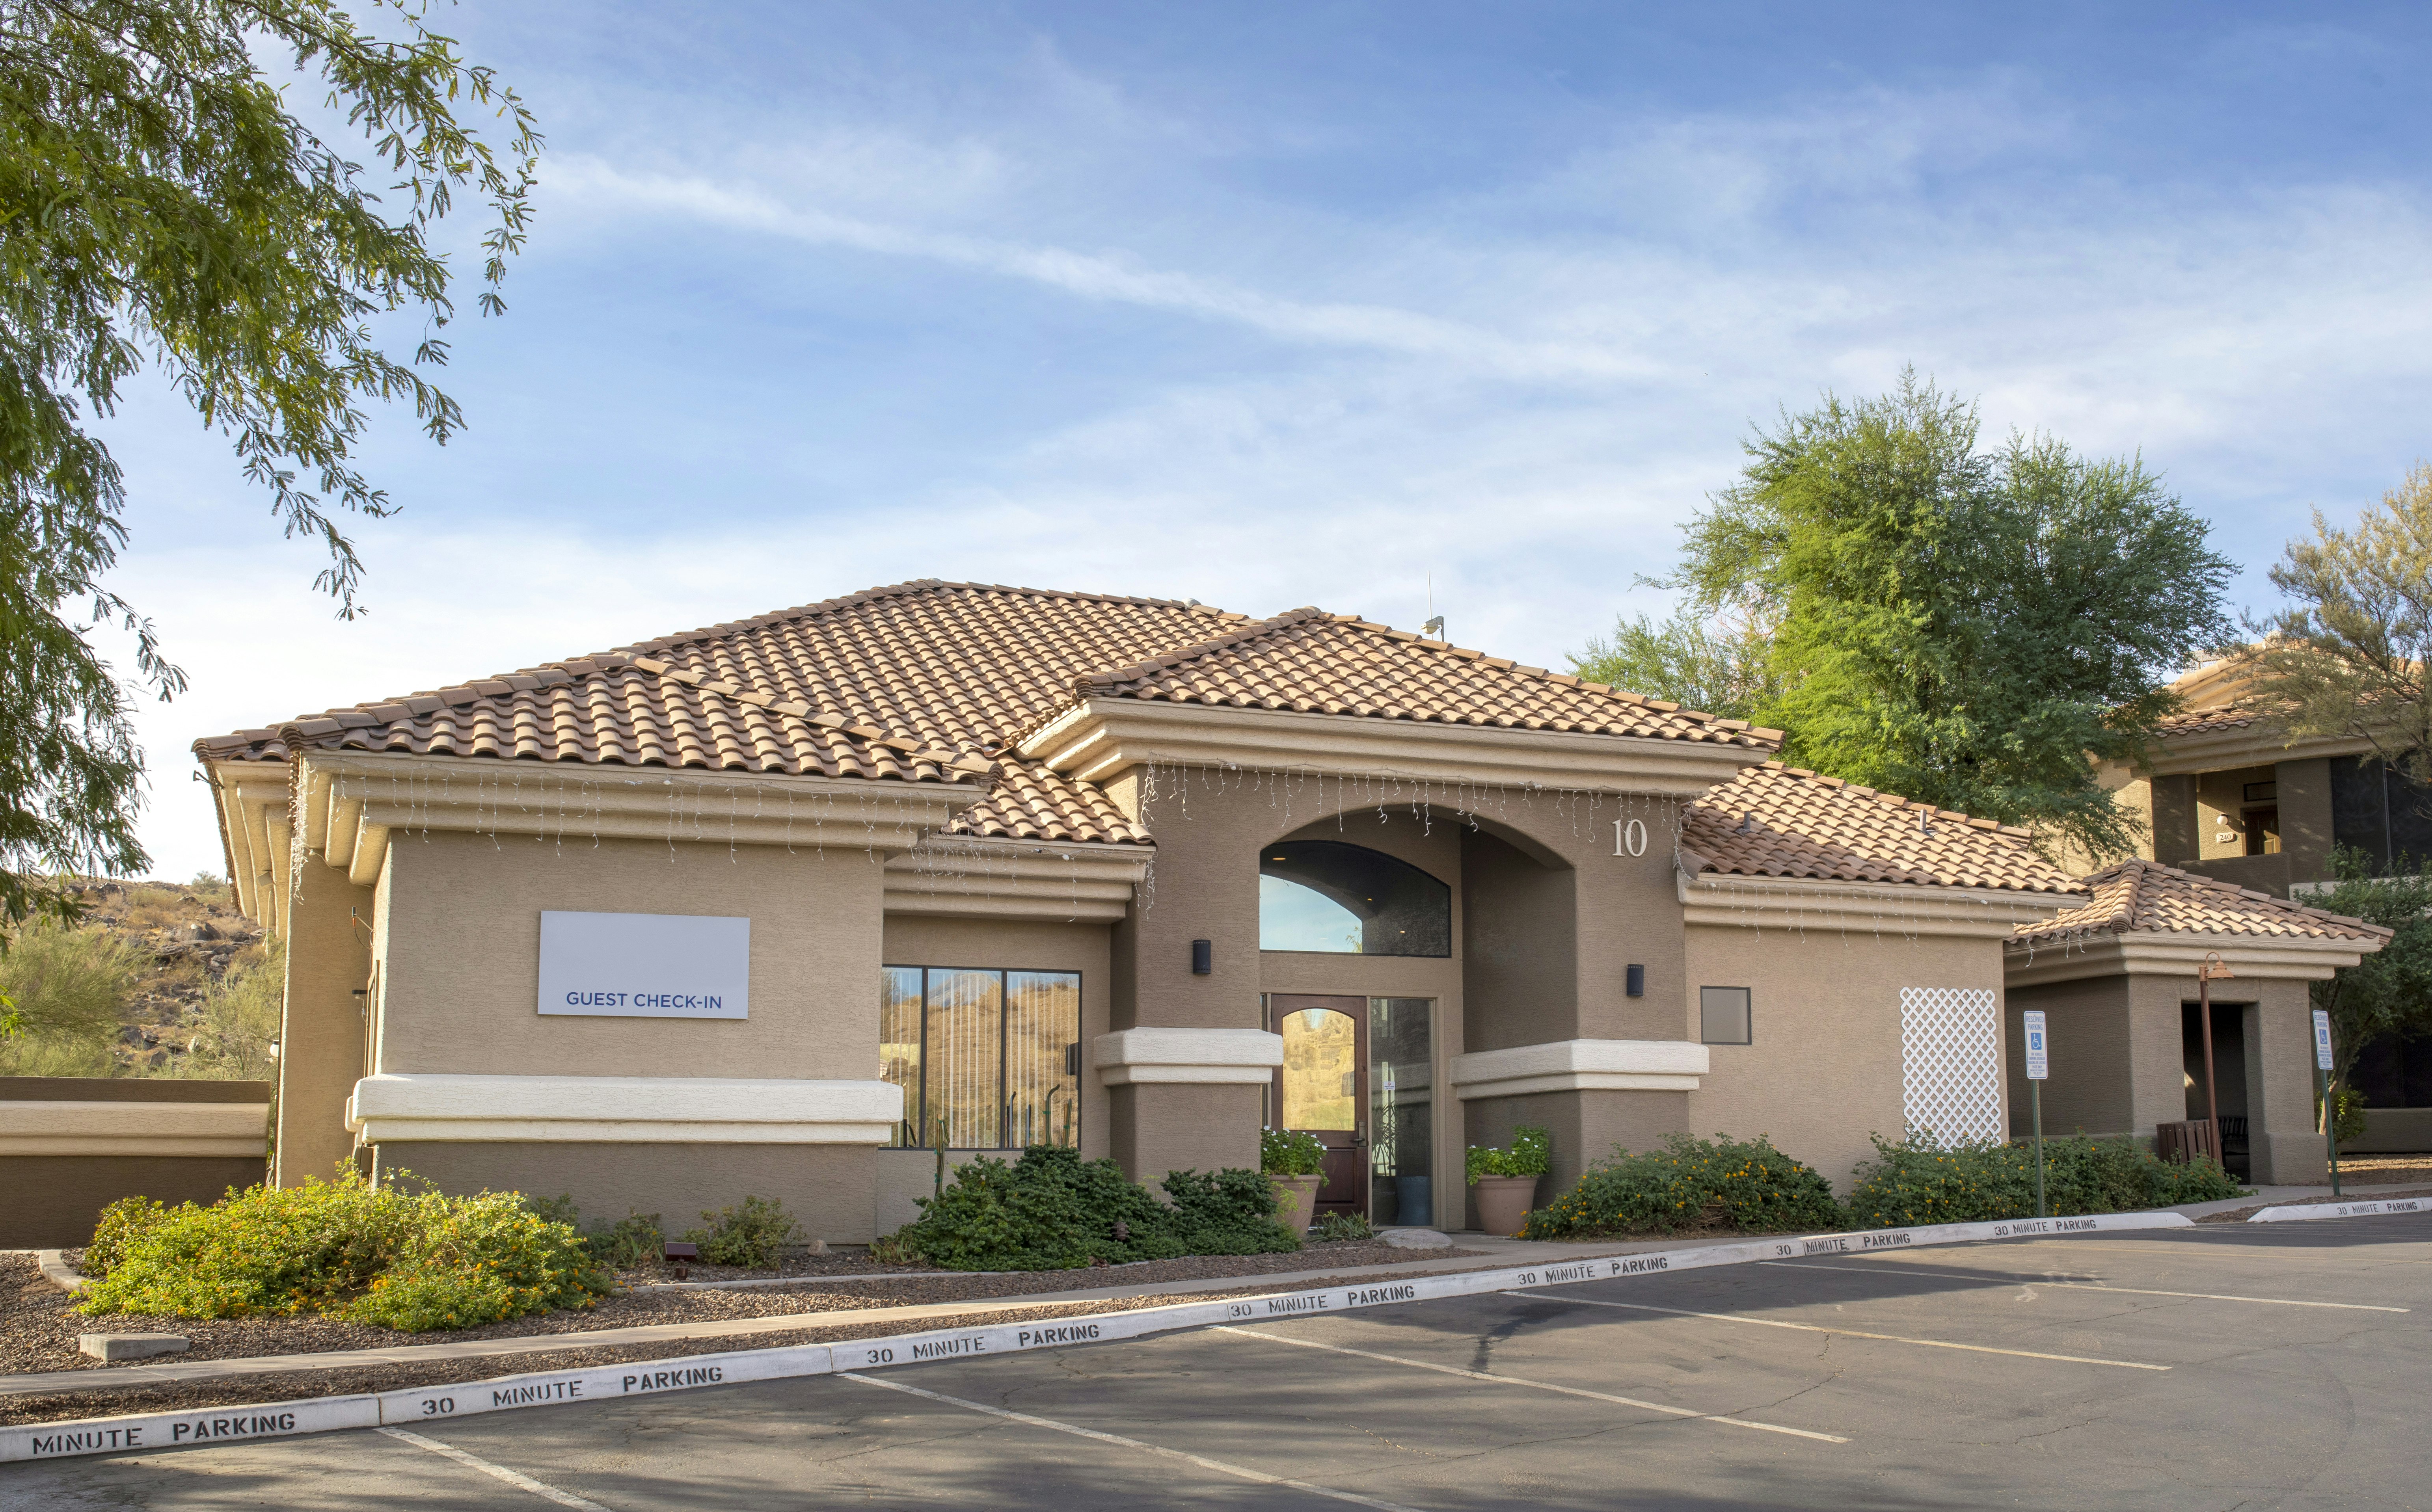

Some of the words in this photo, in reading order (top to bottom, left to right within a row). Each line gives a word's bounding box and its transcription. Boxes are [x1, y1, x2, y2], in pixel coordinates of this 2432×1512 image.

[1612, 819, 1647, 857] 10
[566, 991, 628, 1006] GUEST
[634, 994, 721, 1009] CHECK-IN
[2352, 1204, 2378, 1214] MINUTE
[2387, 1201, 2417, 1212] PARKING
[1995, 1226, 2008, 1236] 30
[2013, 1222, 2048, 1234] MINUTE
[2056, 1220, 2096, 1232] PARKING
[1776, 1245, 1791, 1255] 30
[1806, 1239, 1846, 1252] MINUTE
[1864, 1233, 1911, 1247] PARKING
[1518, 1273, 1536, 1285] 30
[1545, 1264, 1595, 1283] MINUTE
[1612, 1257, 1668, 1275] PARKING
[1231, 1304, 1252, 1316] 30
[1269, 1295, 1328, 1313] MINUTE
[1348, 1285, 1415, 1305] PARKING
[867, 1348, 893, 1363] 30
[913, 1337, 985, 1359] MINUTE
[1019, 1324, 1099, 1346] PARKING
[423, 1397, 454, 1415] 30
[494, 1380, 583, 1406] MINUTE
[624, 1367, 722, 1392] PARKING
[34, 1428, 142, 1454] MINUTE
[173, 1413, 295, 1441] PARKING
